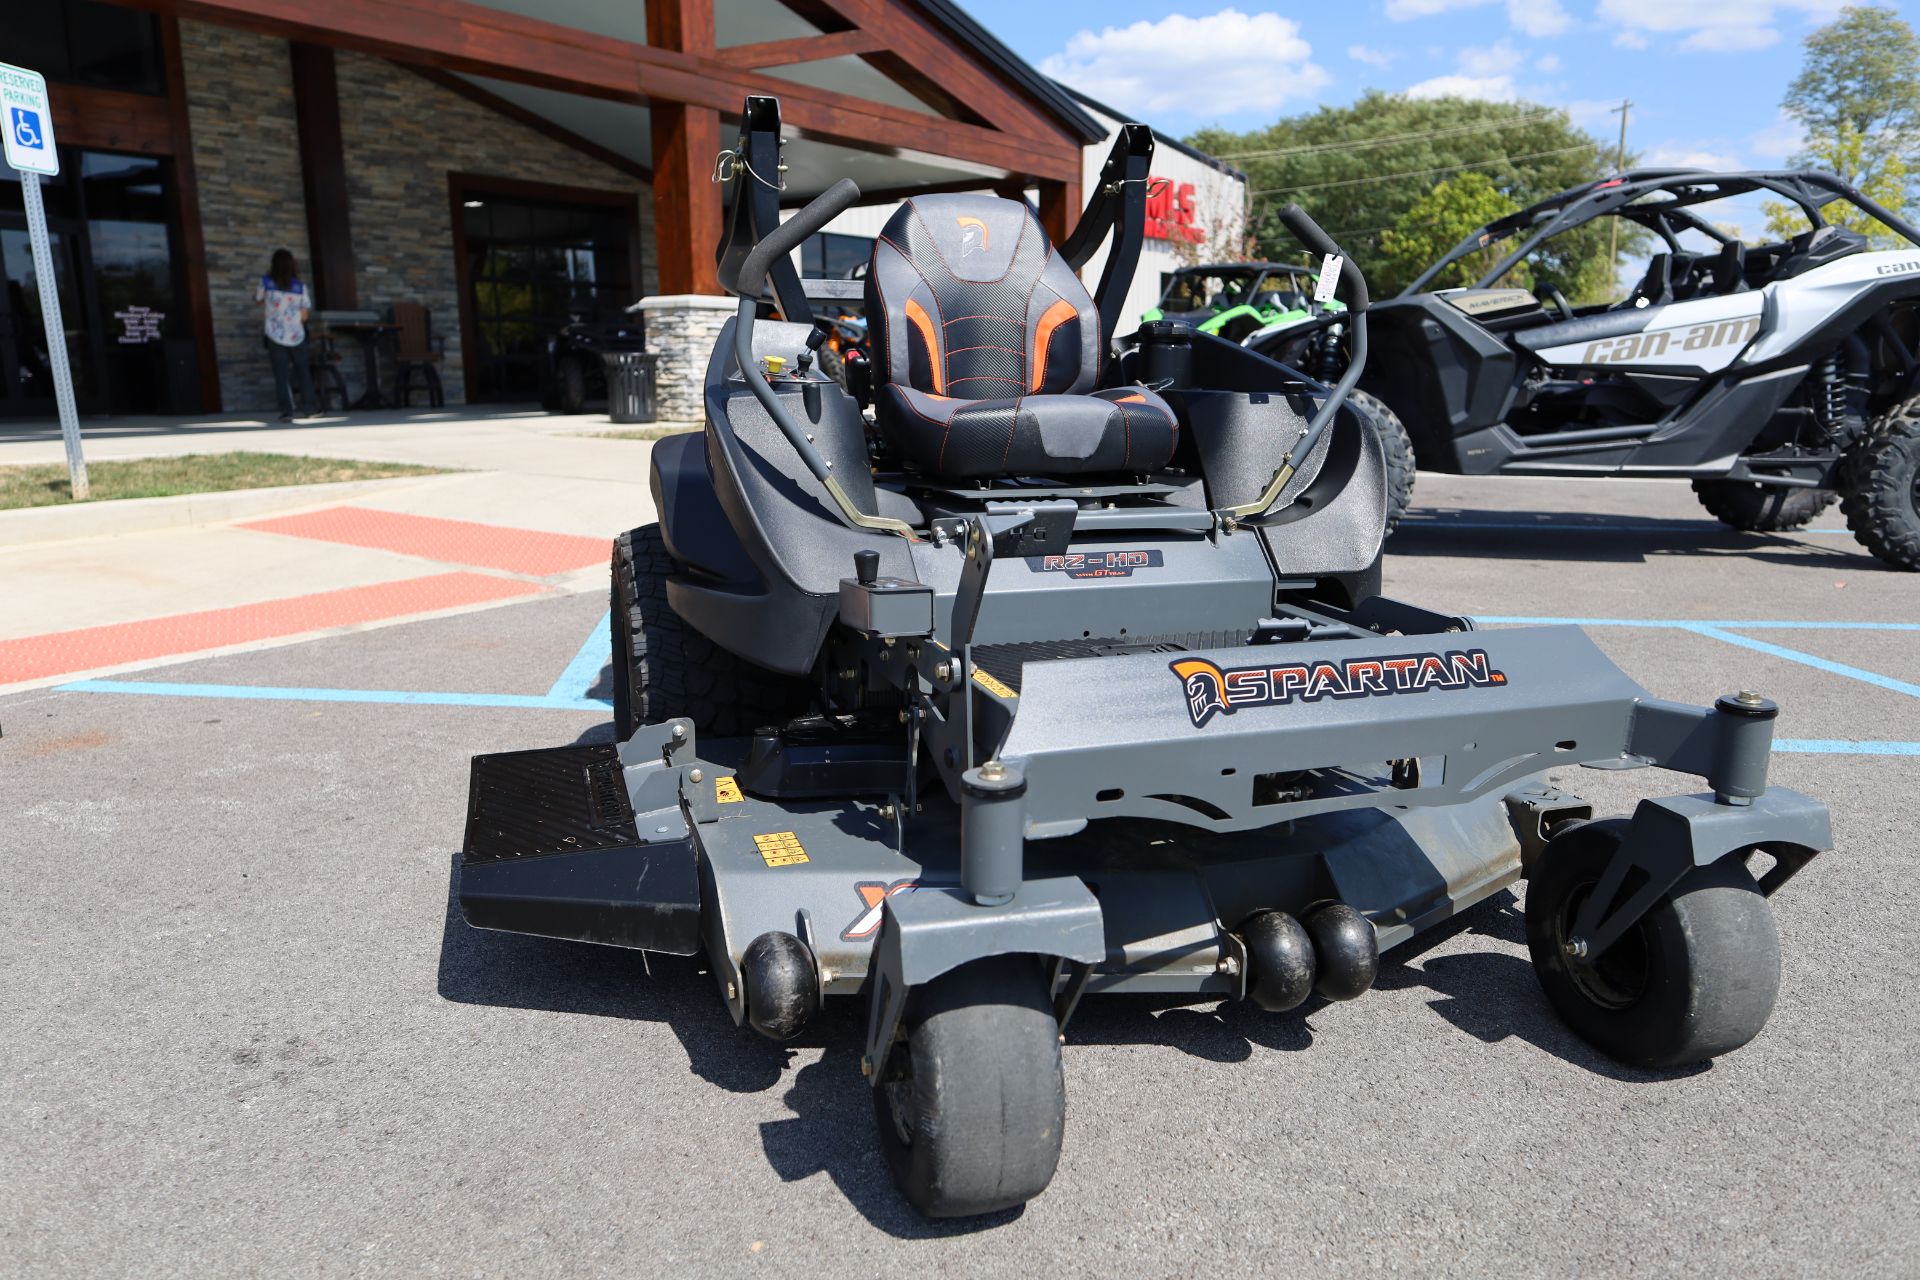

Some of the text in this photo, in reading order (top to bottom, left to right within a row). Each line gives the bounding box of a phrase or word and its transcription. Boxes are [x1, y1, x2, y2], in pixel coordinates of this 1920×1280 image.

[3, 87, 42, 109] PARKING
[1582, 317, 1761, 364] can-am
[1043, 551, 1149, 570] RZ-HD
[1225, 653, 1489, 704] SPARTAN
